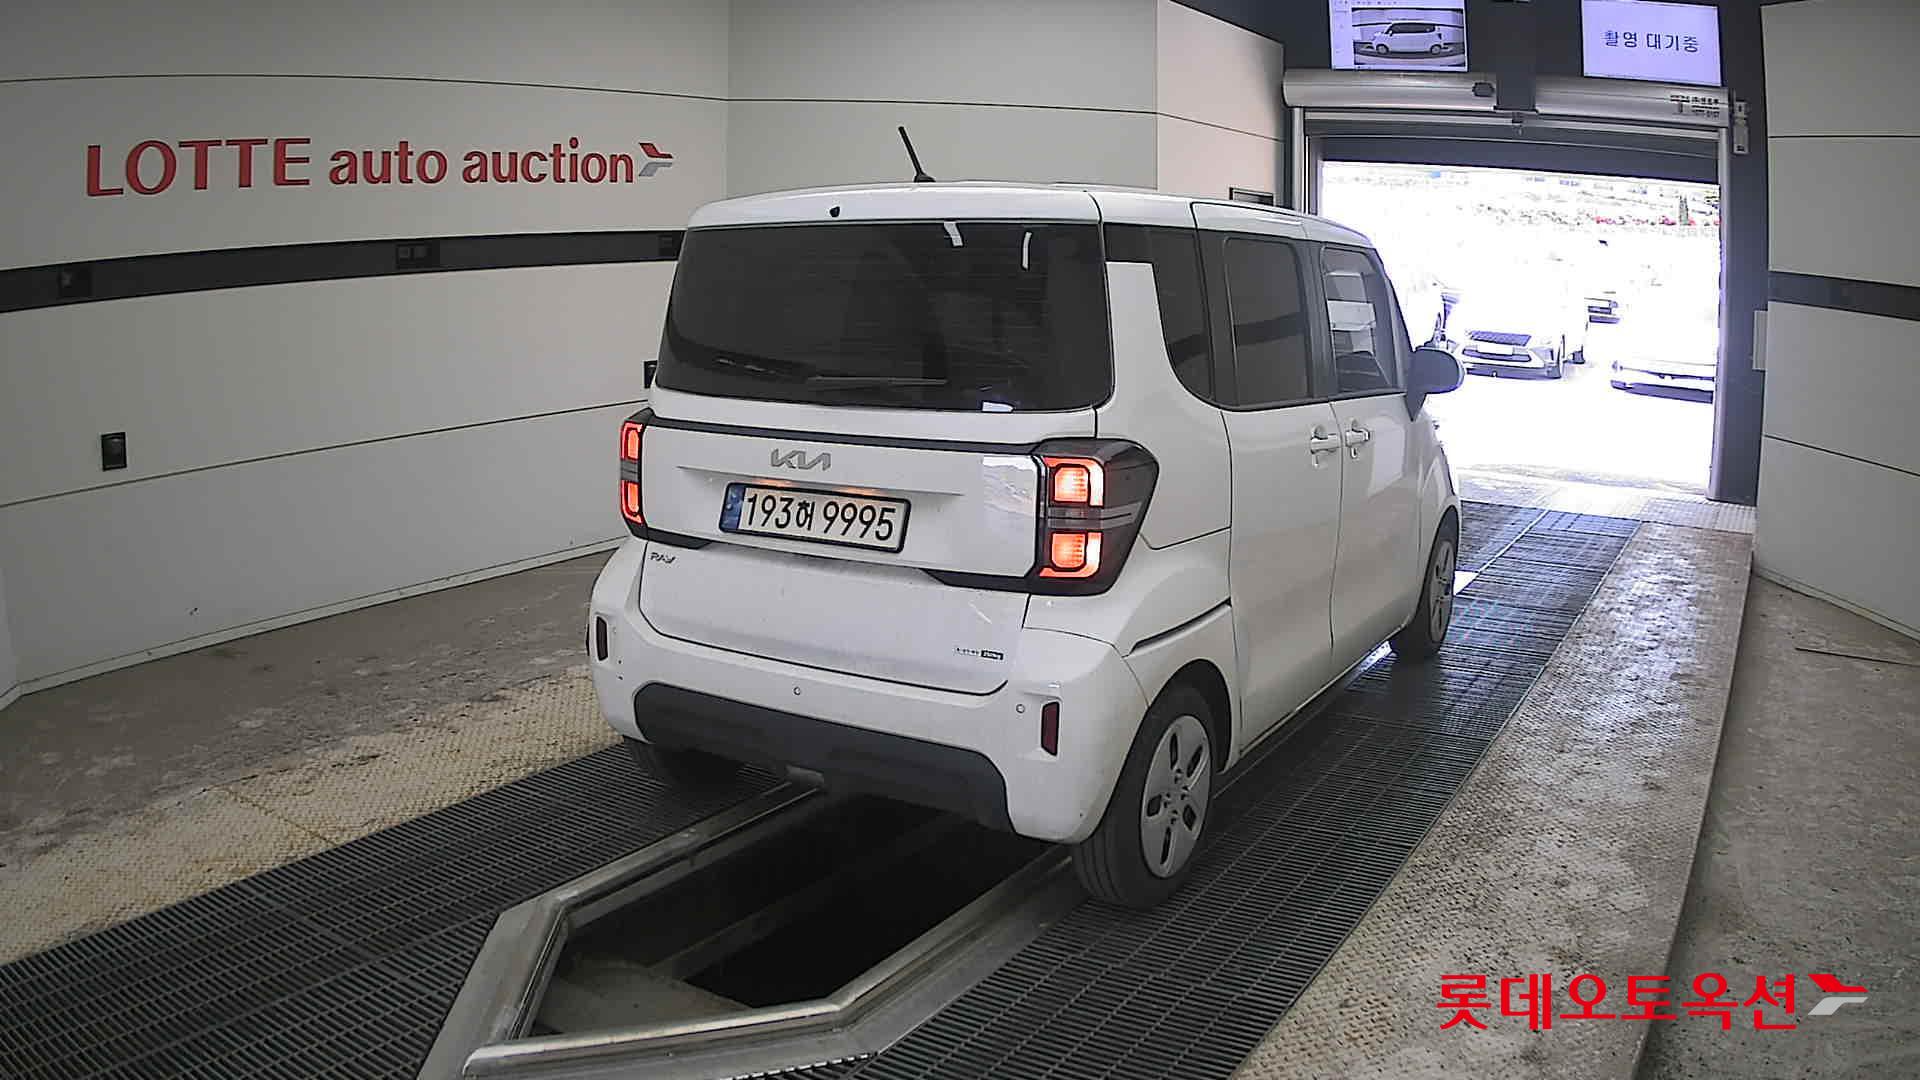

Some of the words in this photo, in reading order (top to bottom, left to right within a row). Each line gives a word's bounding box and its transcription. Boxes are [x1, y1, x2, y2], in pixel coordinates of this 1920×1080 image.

[1646, 33, 1698, 53] 대기중
[86, 138, 311, 197] LOTTE
[329, 141, 448, 185] auto
[462, 138, 634, 184] auction
[770, 449, 832, 471] KIA
[823, 500, 896, 541] 9995
